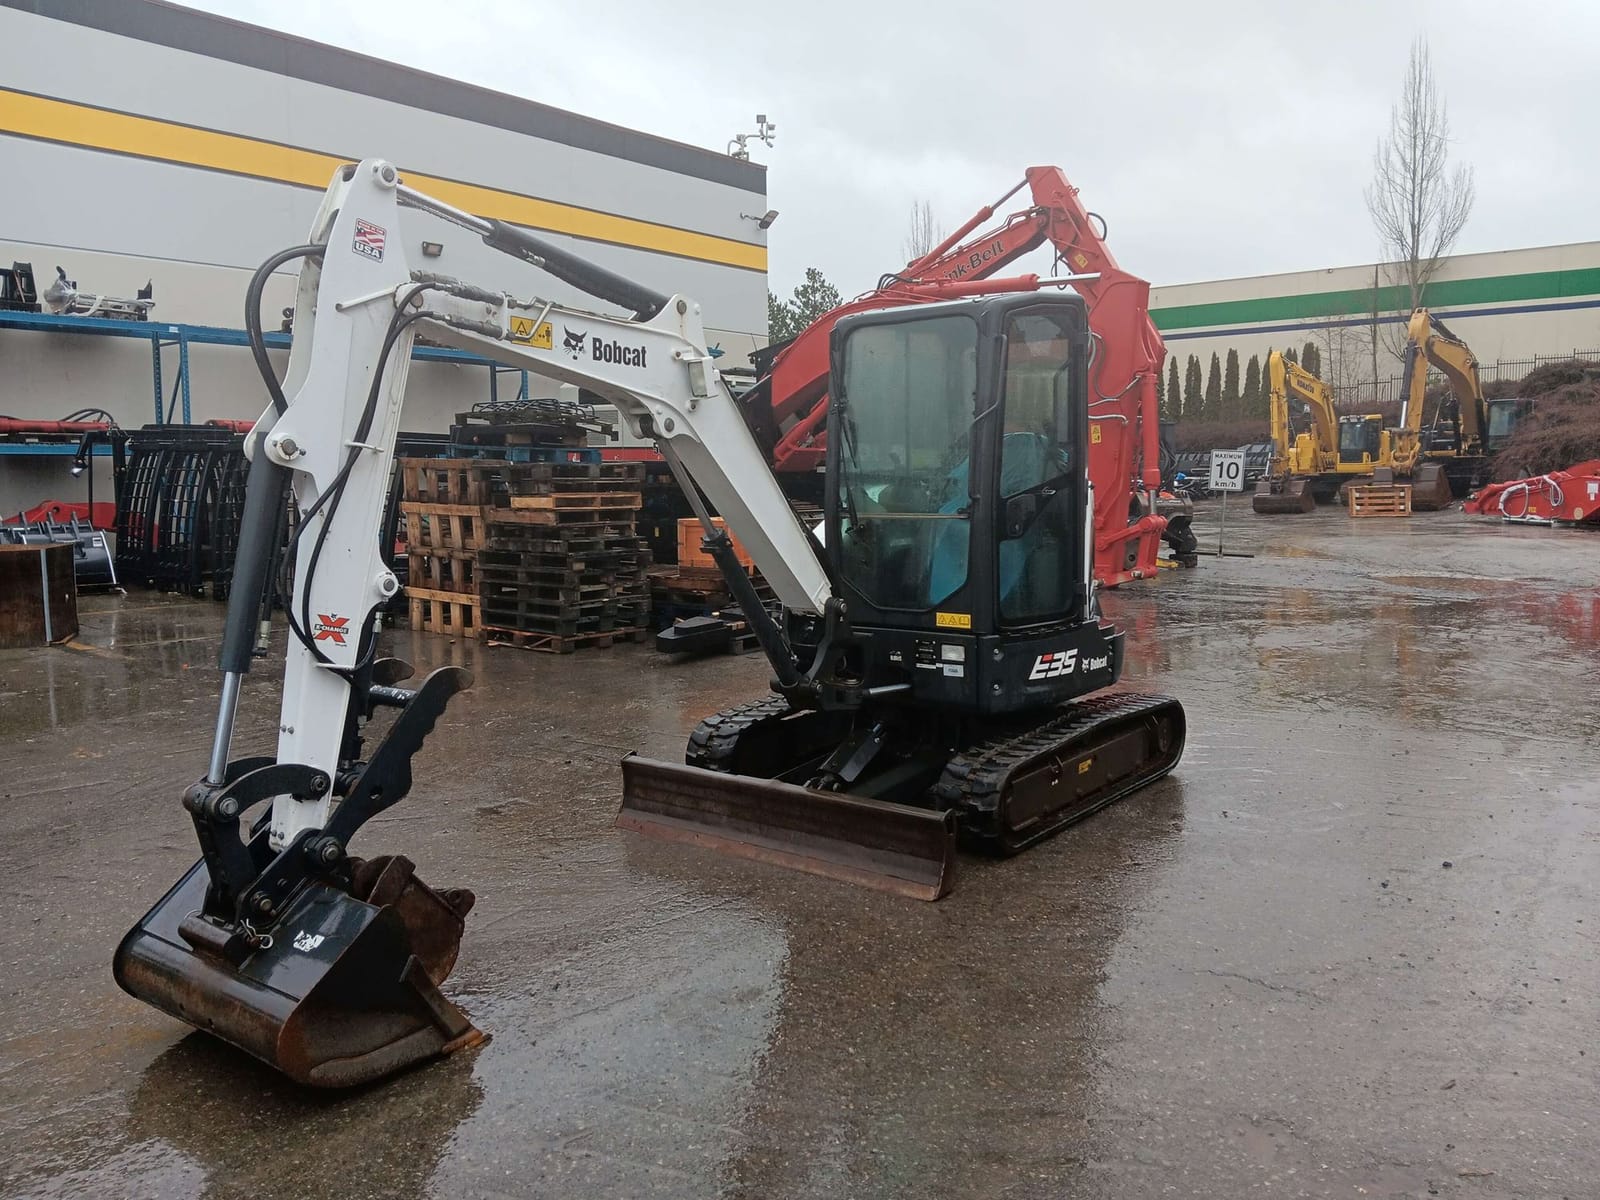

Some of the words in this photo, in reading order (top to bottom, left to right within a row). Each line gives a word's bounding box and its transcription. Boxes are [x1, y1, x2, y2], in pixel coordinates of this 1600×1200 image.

[356, 242, 380, 258] USA
[943, 239, 1004, 280] ink-Belt
[592, 337, 647, 368] Bobcat
[1215, 461, 1240, 480] 10
[1029, 648, 1078, 680] E35
